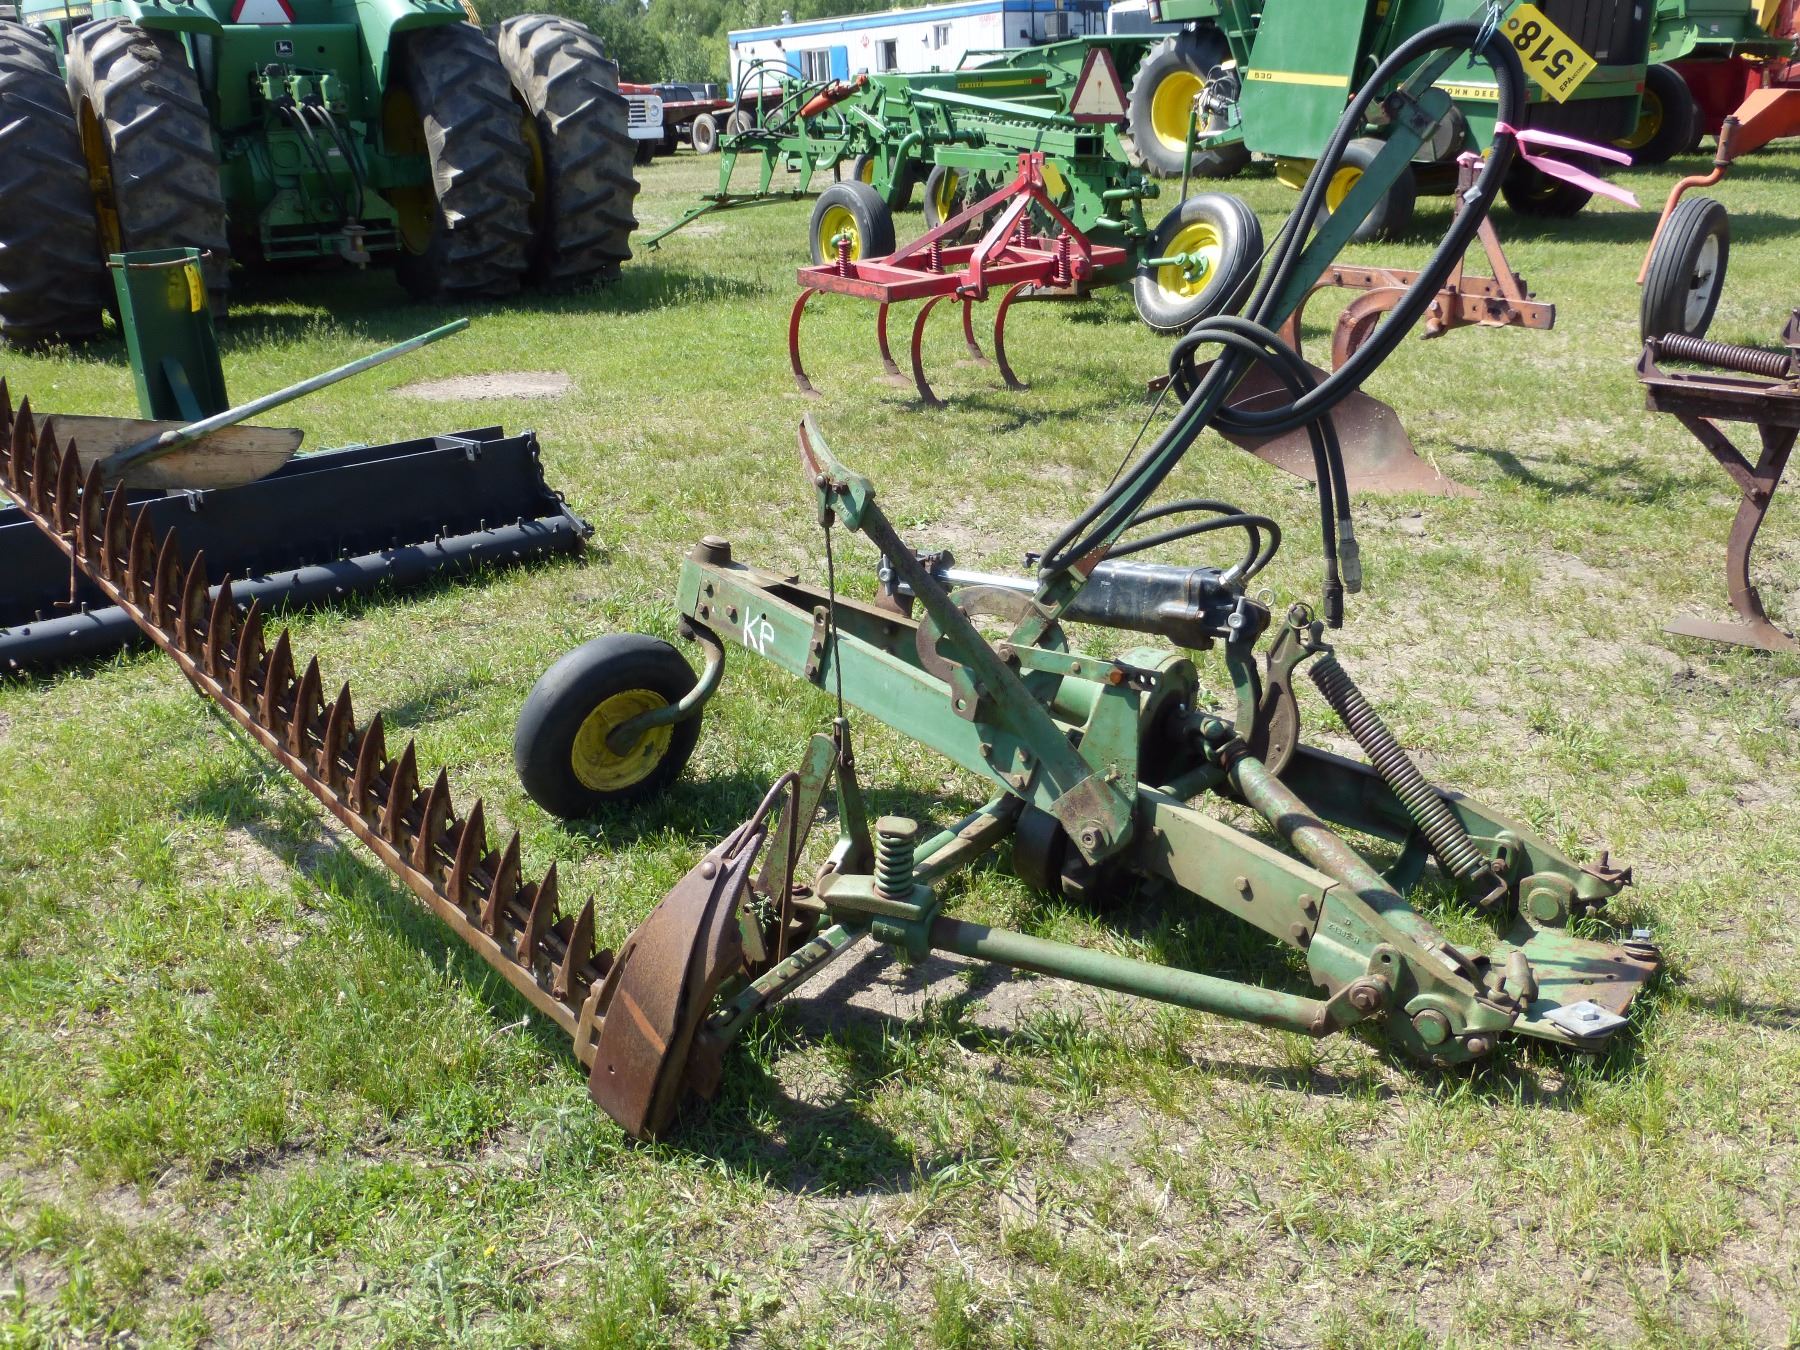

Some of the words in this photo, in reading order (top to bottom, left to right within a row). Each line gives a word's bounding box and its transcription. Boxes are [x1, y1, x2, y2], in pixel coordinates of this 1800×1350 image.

[1513, 20, 1574, 80] 518
[1443, 88, 1468, 96] OHN
[1474, 90, 1499, 98] DEE
[743, 606, 775, 656] KP
